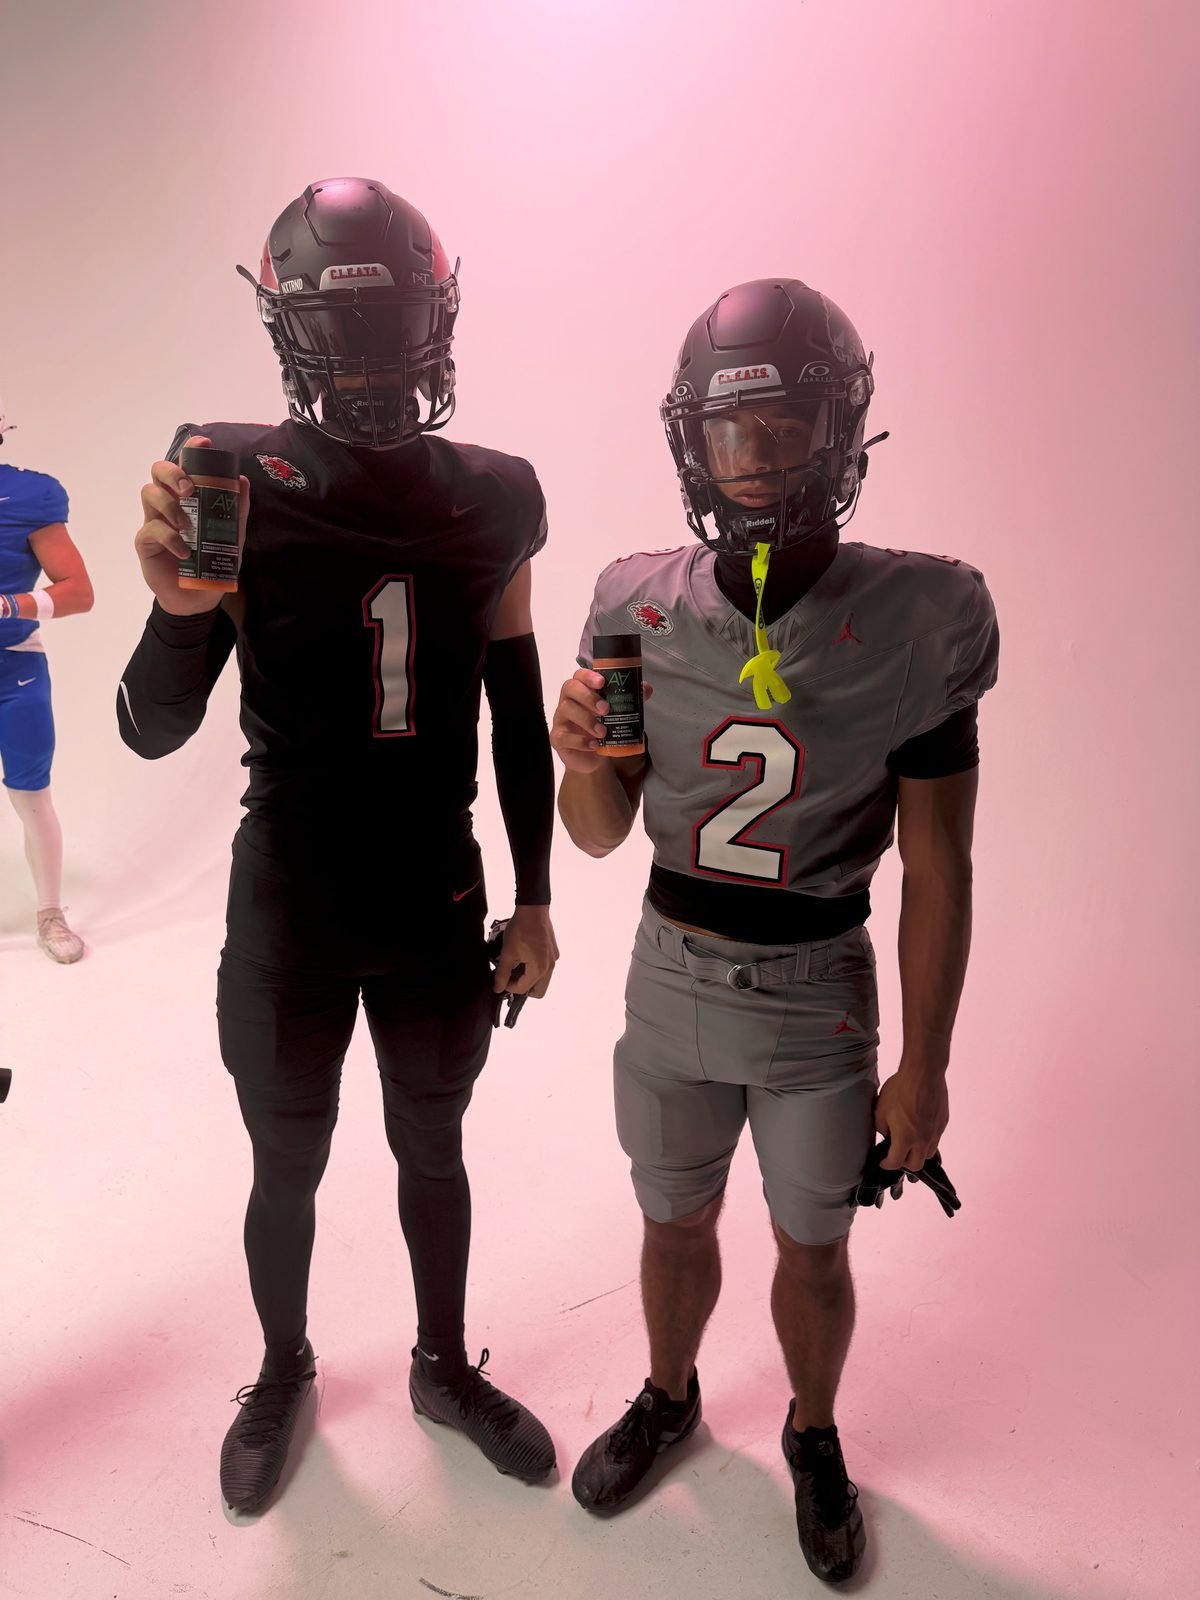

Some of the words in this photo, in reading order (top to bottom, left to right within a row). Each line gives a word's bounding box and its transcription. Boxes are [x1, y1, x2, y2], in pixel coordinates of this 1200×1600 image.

[281, 278, 303, 294] NXTRND
[746, 516, 776, 527] Riddell
[362, 574, 417, 738] 1
[692, 716, 806, 888] 2
